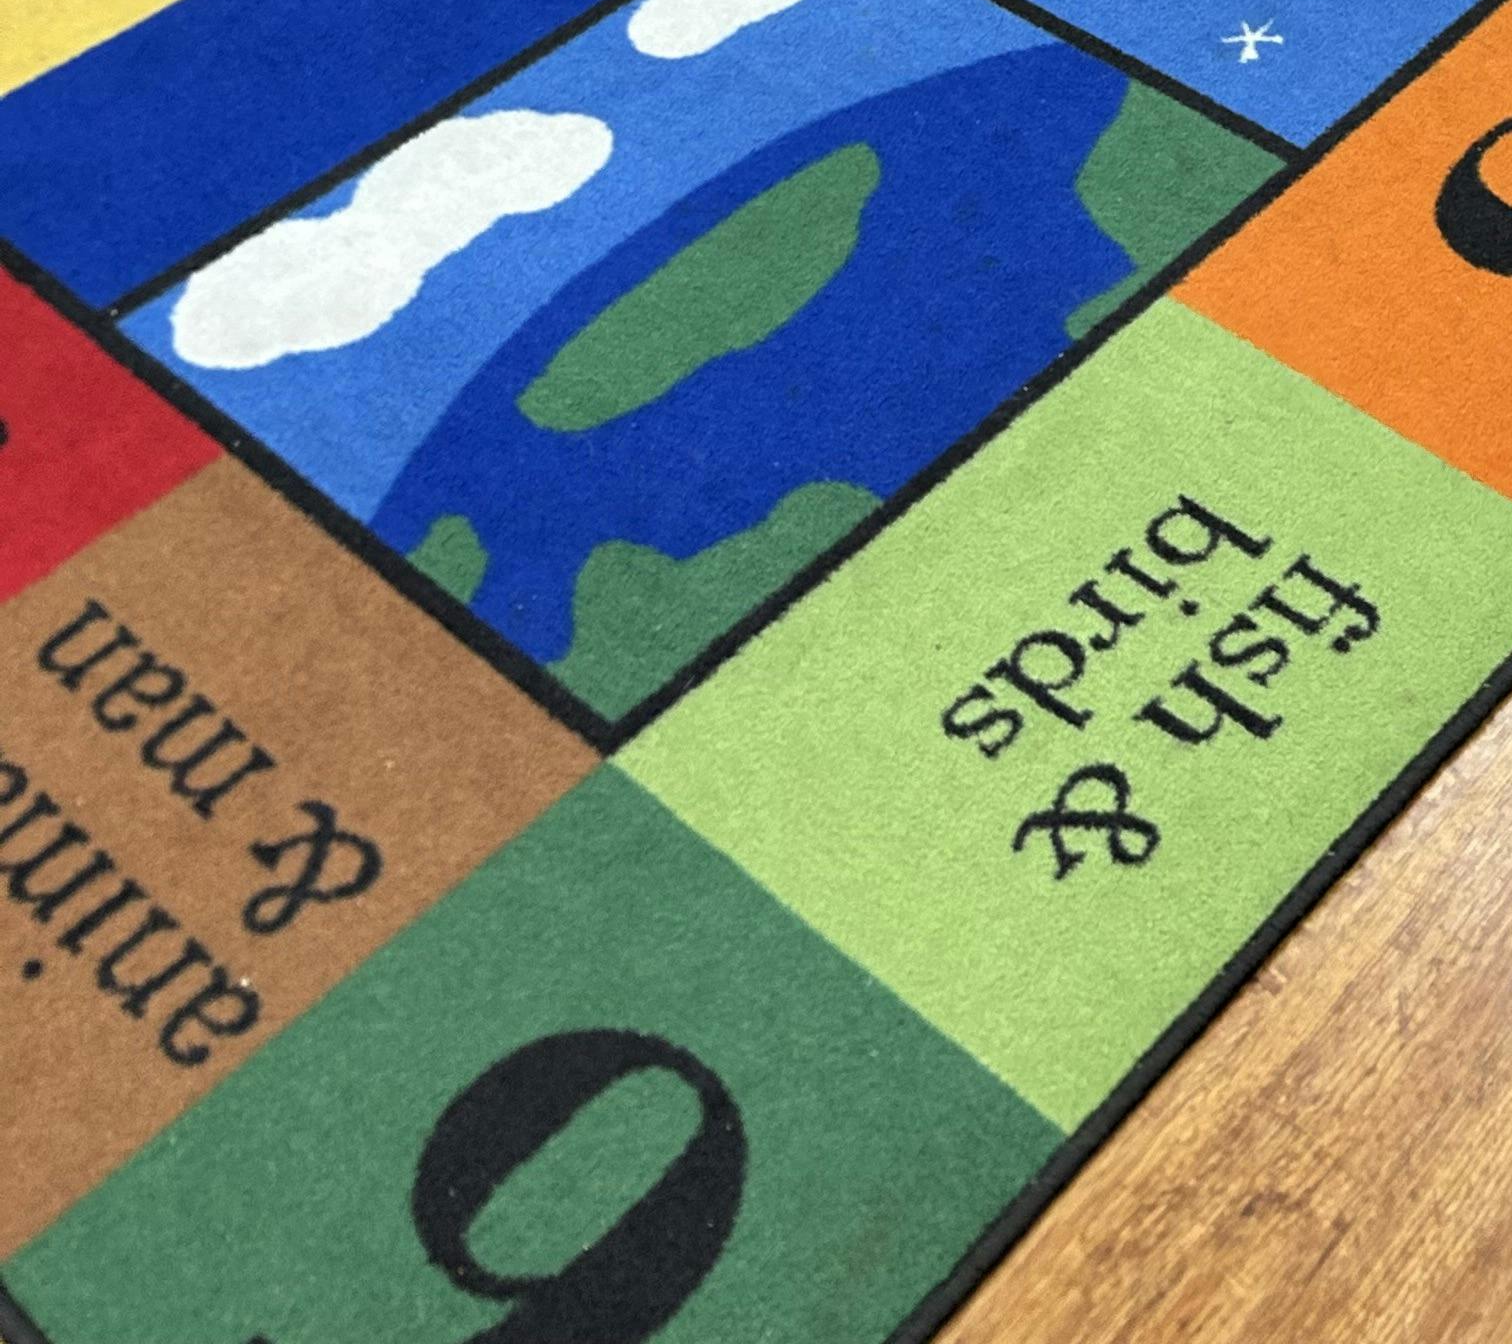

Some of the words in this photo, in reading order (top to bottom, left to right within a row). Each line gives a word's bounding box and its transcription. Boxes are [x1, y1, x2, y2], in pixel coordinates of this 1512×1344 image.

[37, 598, 277, 820] man
[941, 494, 1273, 759] birds
[1133, 554, 1381, 745] fish
[0, 754, 261, 1068] anim
[242, 799, 384, 935] &
[1012, 763, 1160, 881] &
